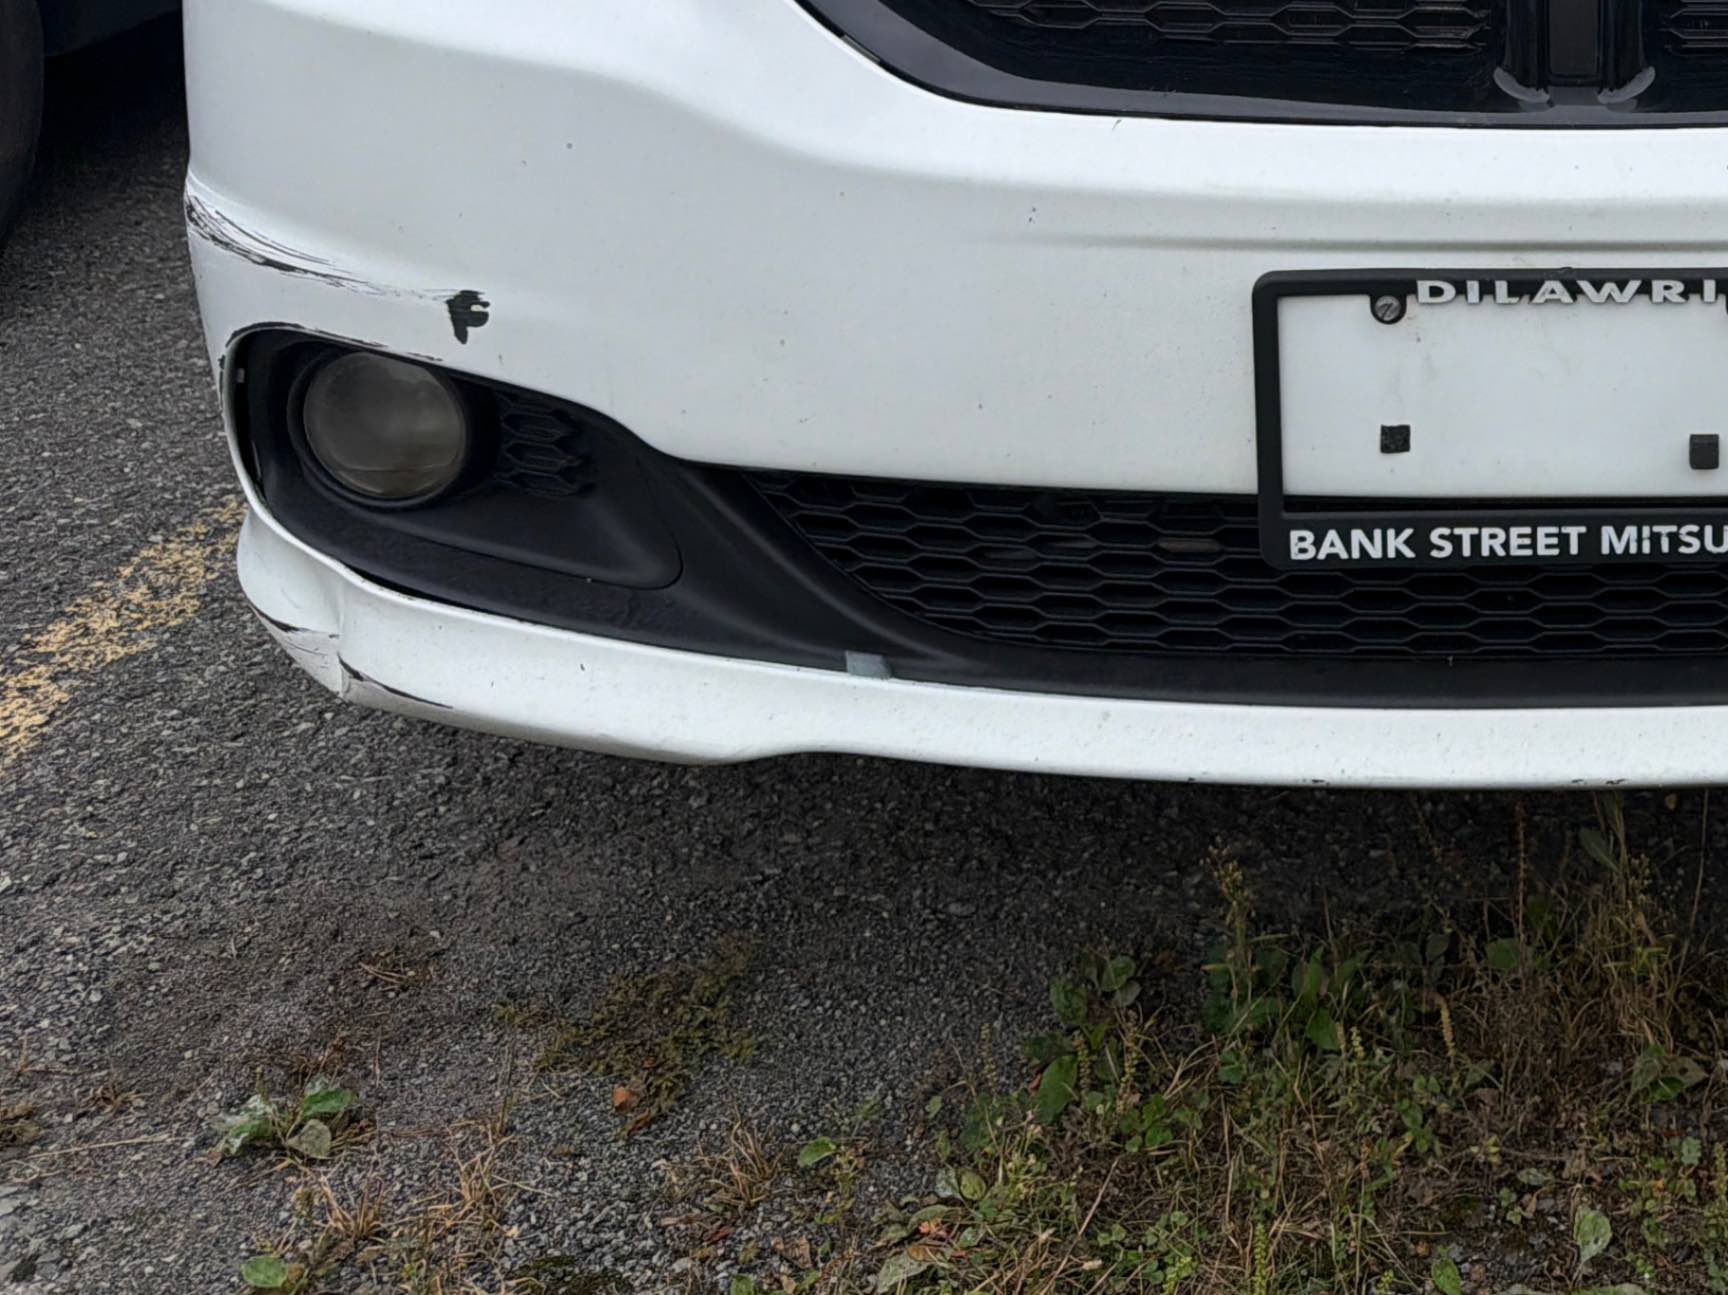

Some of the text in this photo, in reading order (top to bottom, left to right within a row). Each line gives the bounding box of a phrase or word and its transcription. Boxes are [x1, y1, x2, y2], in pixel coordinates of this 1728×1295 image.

[1416, 279, 1717, 305] DILAWRI
[1289, 527, 1416, 561] BANK
[1429, 526, 1587, 558] STREET
